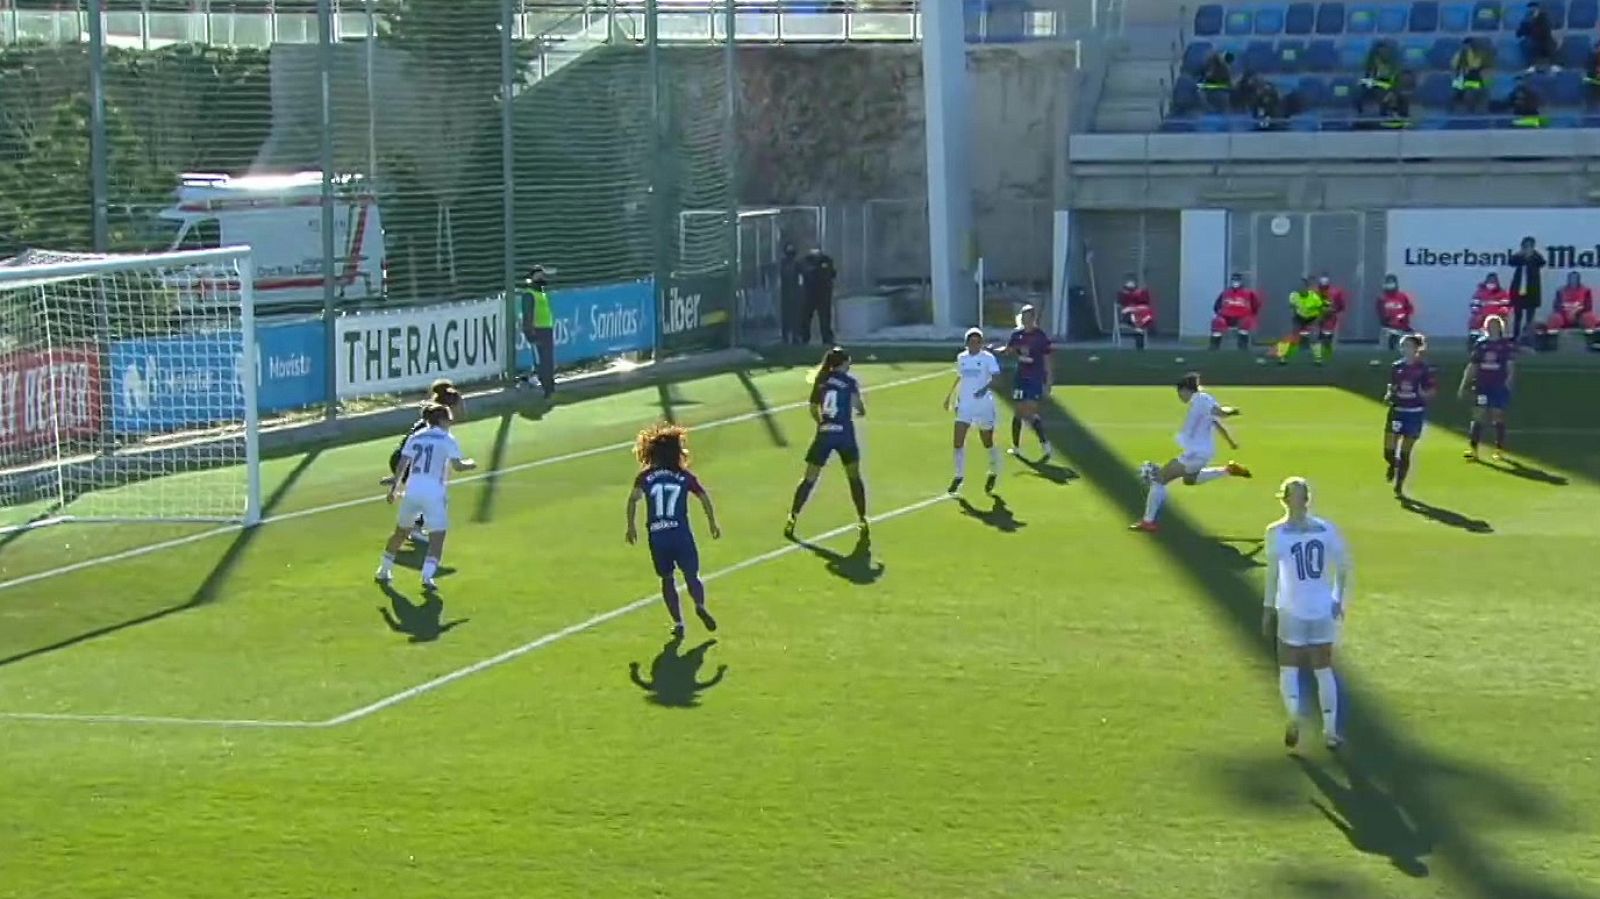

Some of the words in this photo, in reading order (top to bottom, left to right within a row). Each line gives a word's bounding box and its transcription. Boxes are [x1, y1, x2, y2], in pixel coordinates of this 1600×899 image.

[589, 303, 638, 341] Sanitas
[661, 287, 701, 335] Liber
[343, 314, 497, 384] THERAGUN
[823, 390, 838, 418] 4
[412, 443, 434, 474] 21
[650, 483, 681, 517] 17
[1291, 539, 1324, 580] 10
